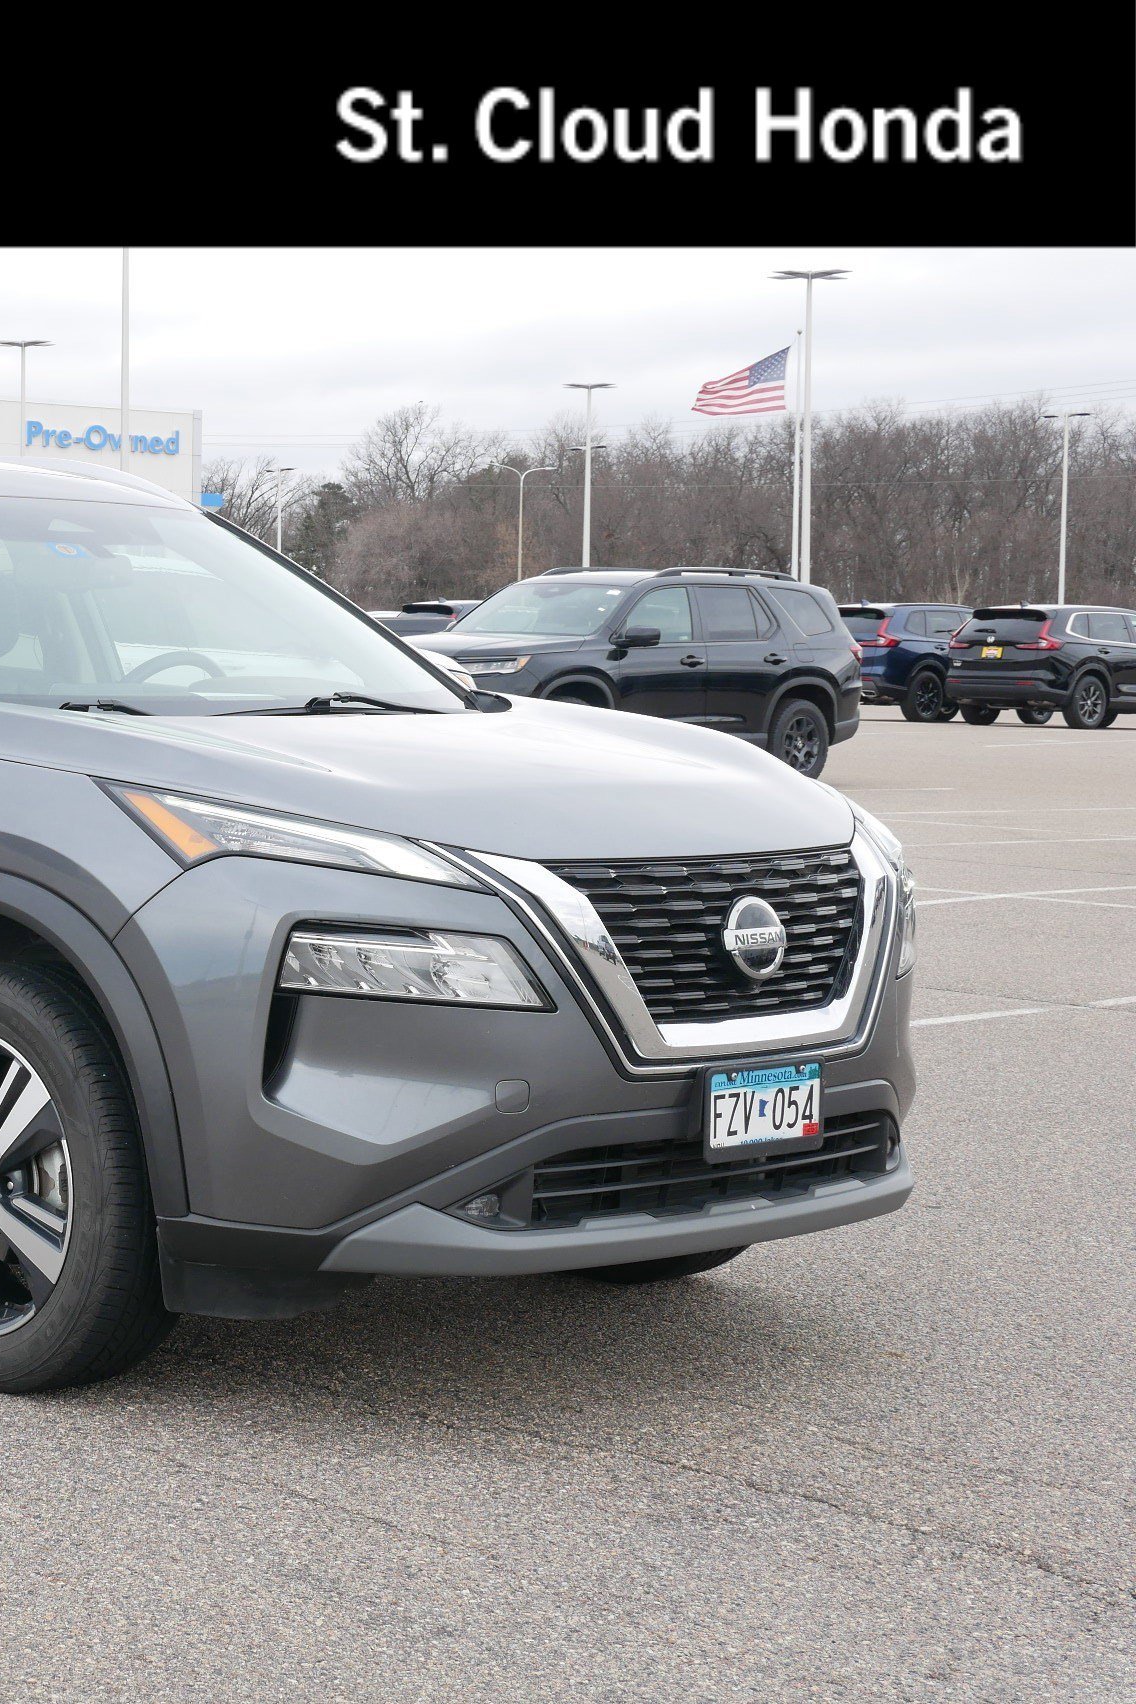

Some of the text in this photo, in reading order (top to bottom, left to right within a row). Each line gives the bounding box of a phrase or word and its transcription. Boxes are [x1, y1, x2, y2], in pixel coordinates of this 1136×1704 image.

[25, 420, 180, 455] Pre-Owned
[734, 930, 783, 946] NISSAN
[713, 1083, 815, 1140] FZV 054
